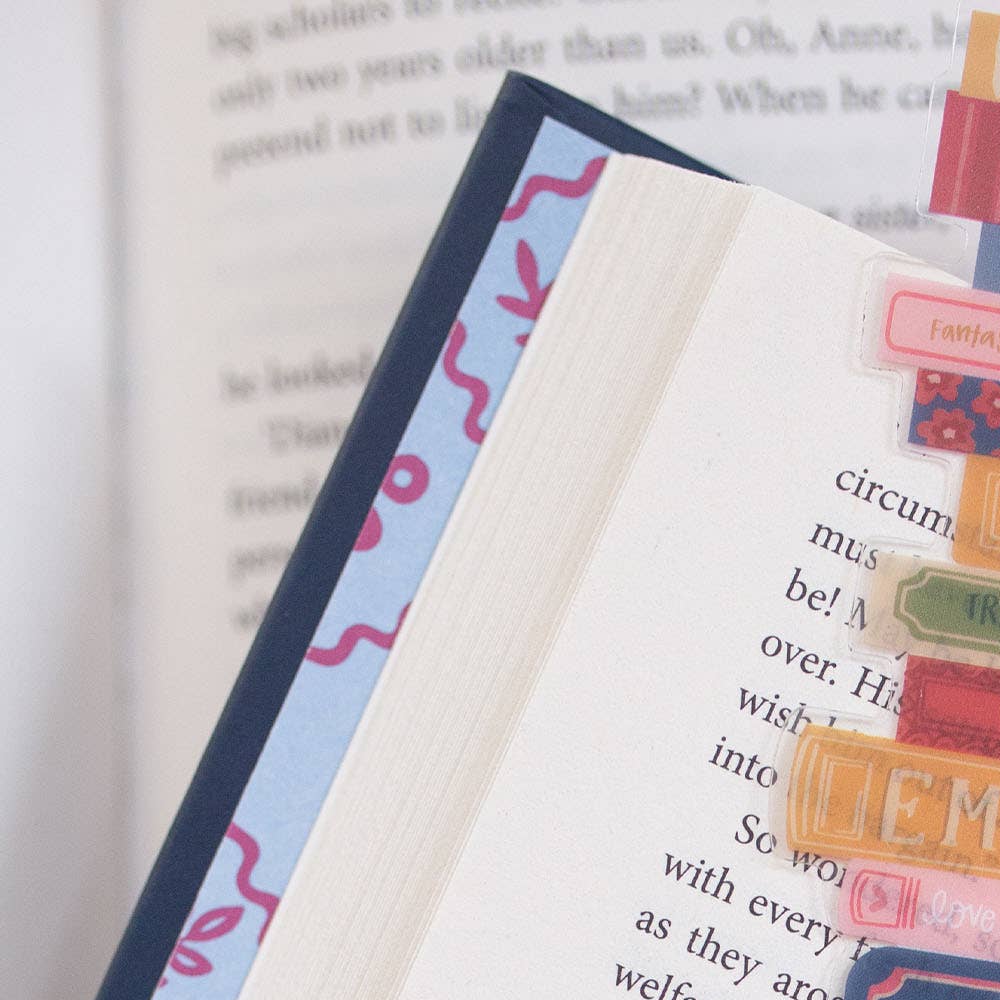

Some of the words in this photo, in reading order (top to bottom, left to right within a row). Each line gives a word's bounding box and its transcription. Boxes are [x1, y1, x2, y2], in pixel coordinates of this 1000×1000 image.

[785, 566, 842, 617] be!
[760, 635, 838, 686] over.
[707, 735, 778, 789] into
[734, 813, 778, 855] So
[664, 852, 735, 905] with
[748, 895, 844, 957] every
[635, 910, 672, 940] as
[686, 926, 764, 987] they
